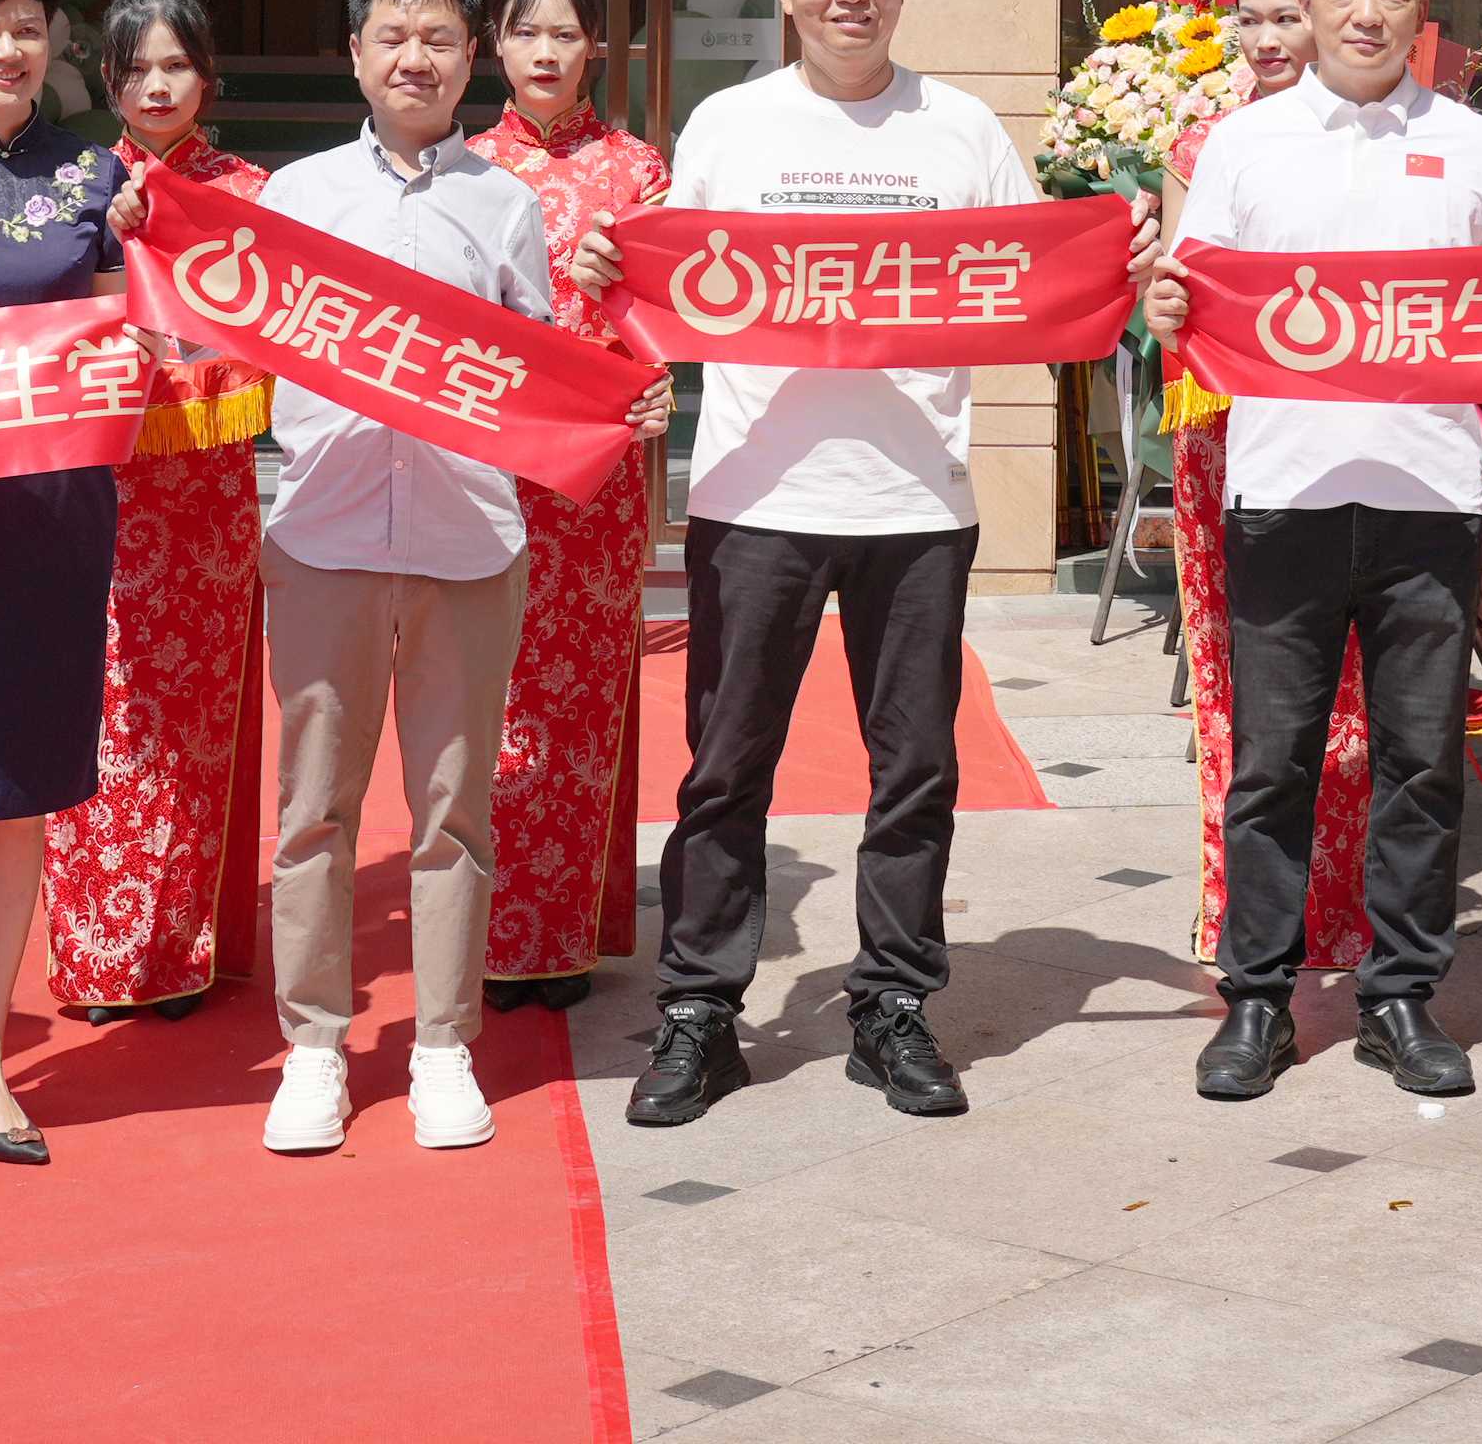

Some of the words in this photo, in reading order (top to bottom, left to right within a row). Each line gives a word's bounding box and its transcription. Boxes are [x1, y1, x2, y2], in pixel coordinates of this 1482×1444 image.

[780, 172, 844, 185] BEFORE
[849, 172, 919, 188] ANYONE
[772, 239, 1031, 326] 源生堂
[259, 263, 529, 432] 源生堂
